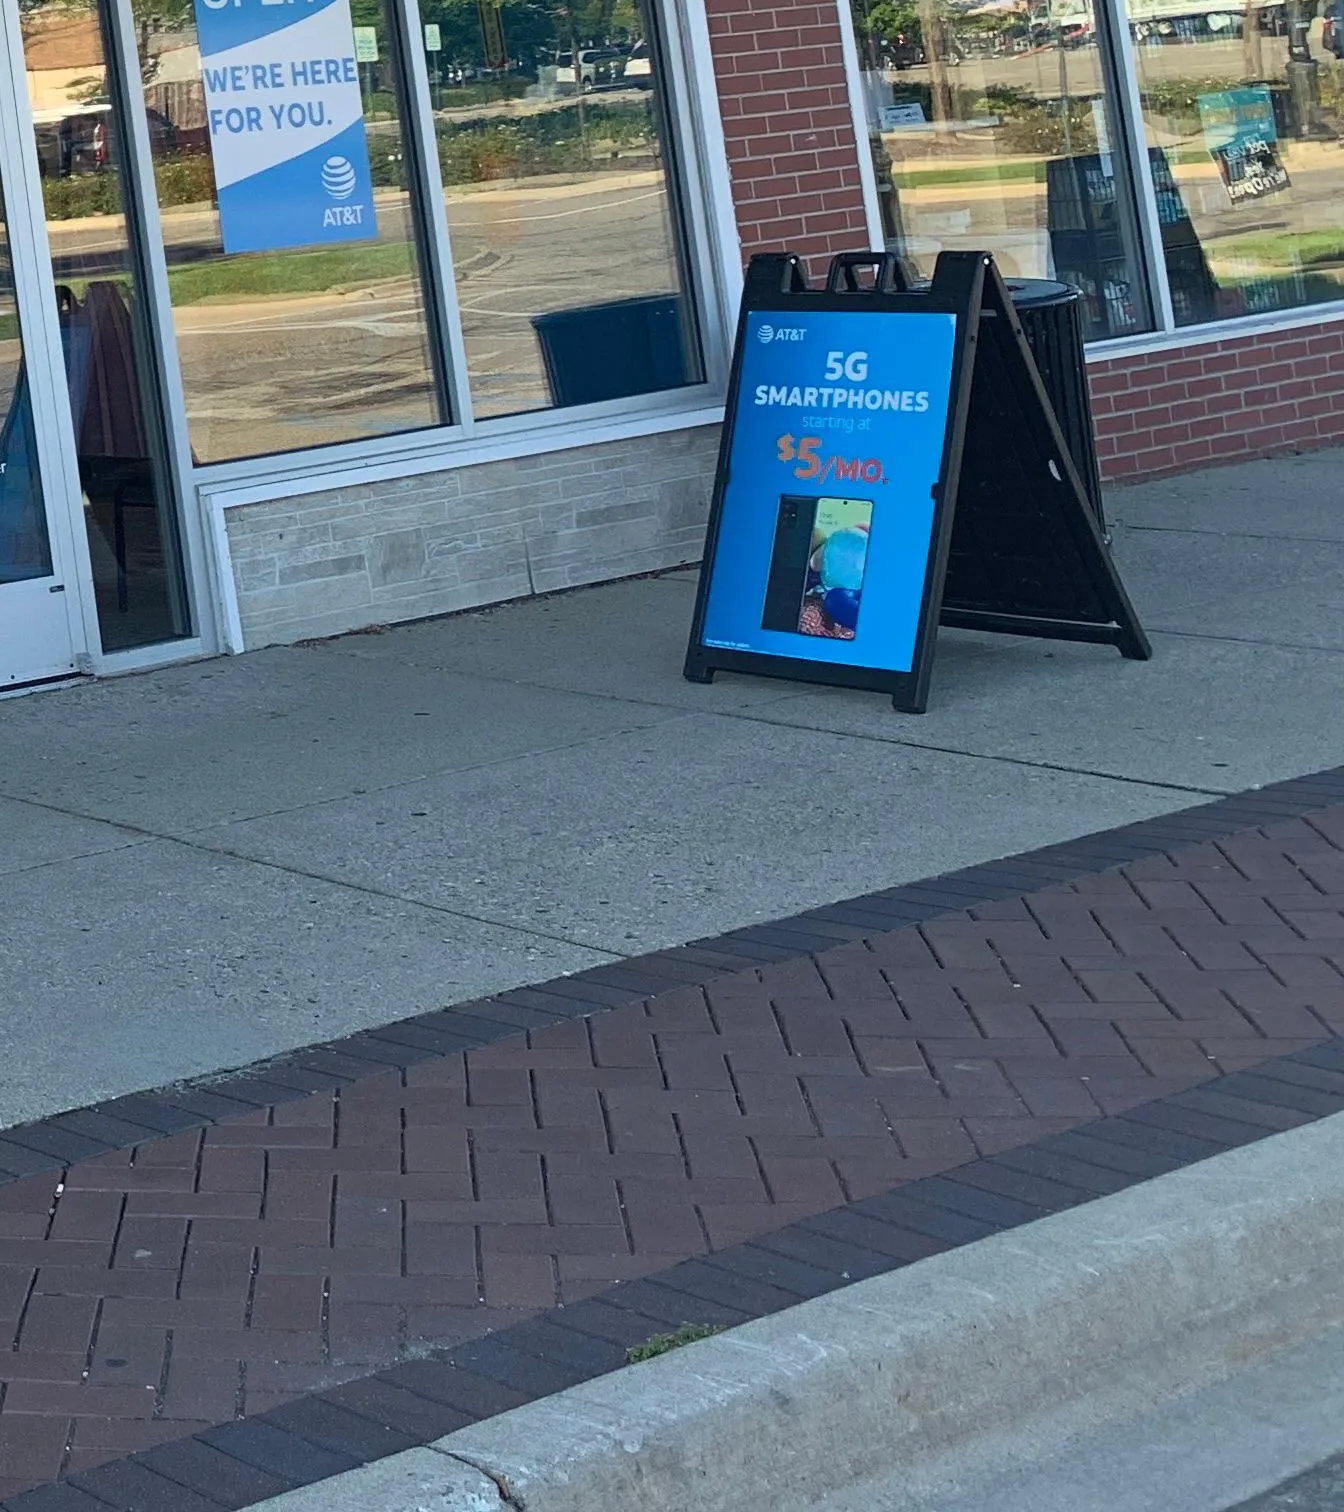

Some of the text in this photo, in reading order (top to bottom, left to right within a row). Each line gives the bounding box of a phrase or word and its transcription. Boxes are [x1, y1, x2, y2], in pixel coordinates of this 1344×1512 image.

[204, 57, 358, 93] WE'RE HERE
[210, 101, 332, 135] FOR YOU.
[323, 204, 364, 228] AT&T
[775, 328, 808, 341] AT&T
[823, 351, 869, 383] 5G
[754, 385, 930, 413] SMARTPHONES
[802, 414, 872, 434] starting at
